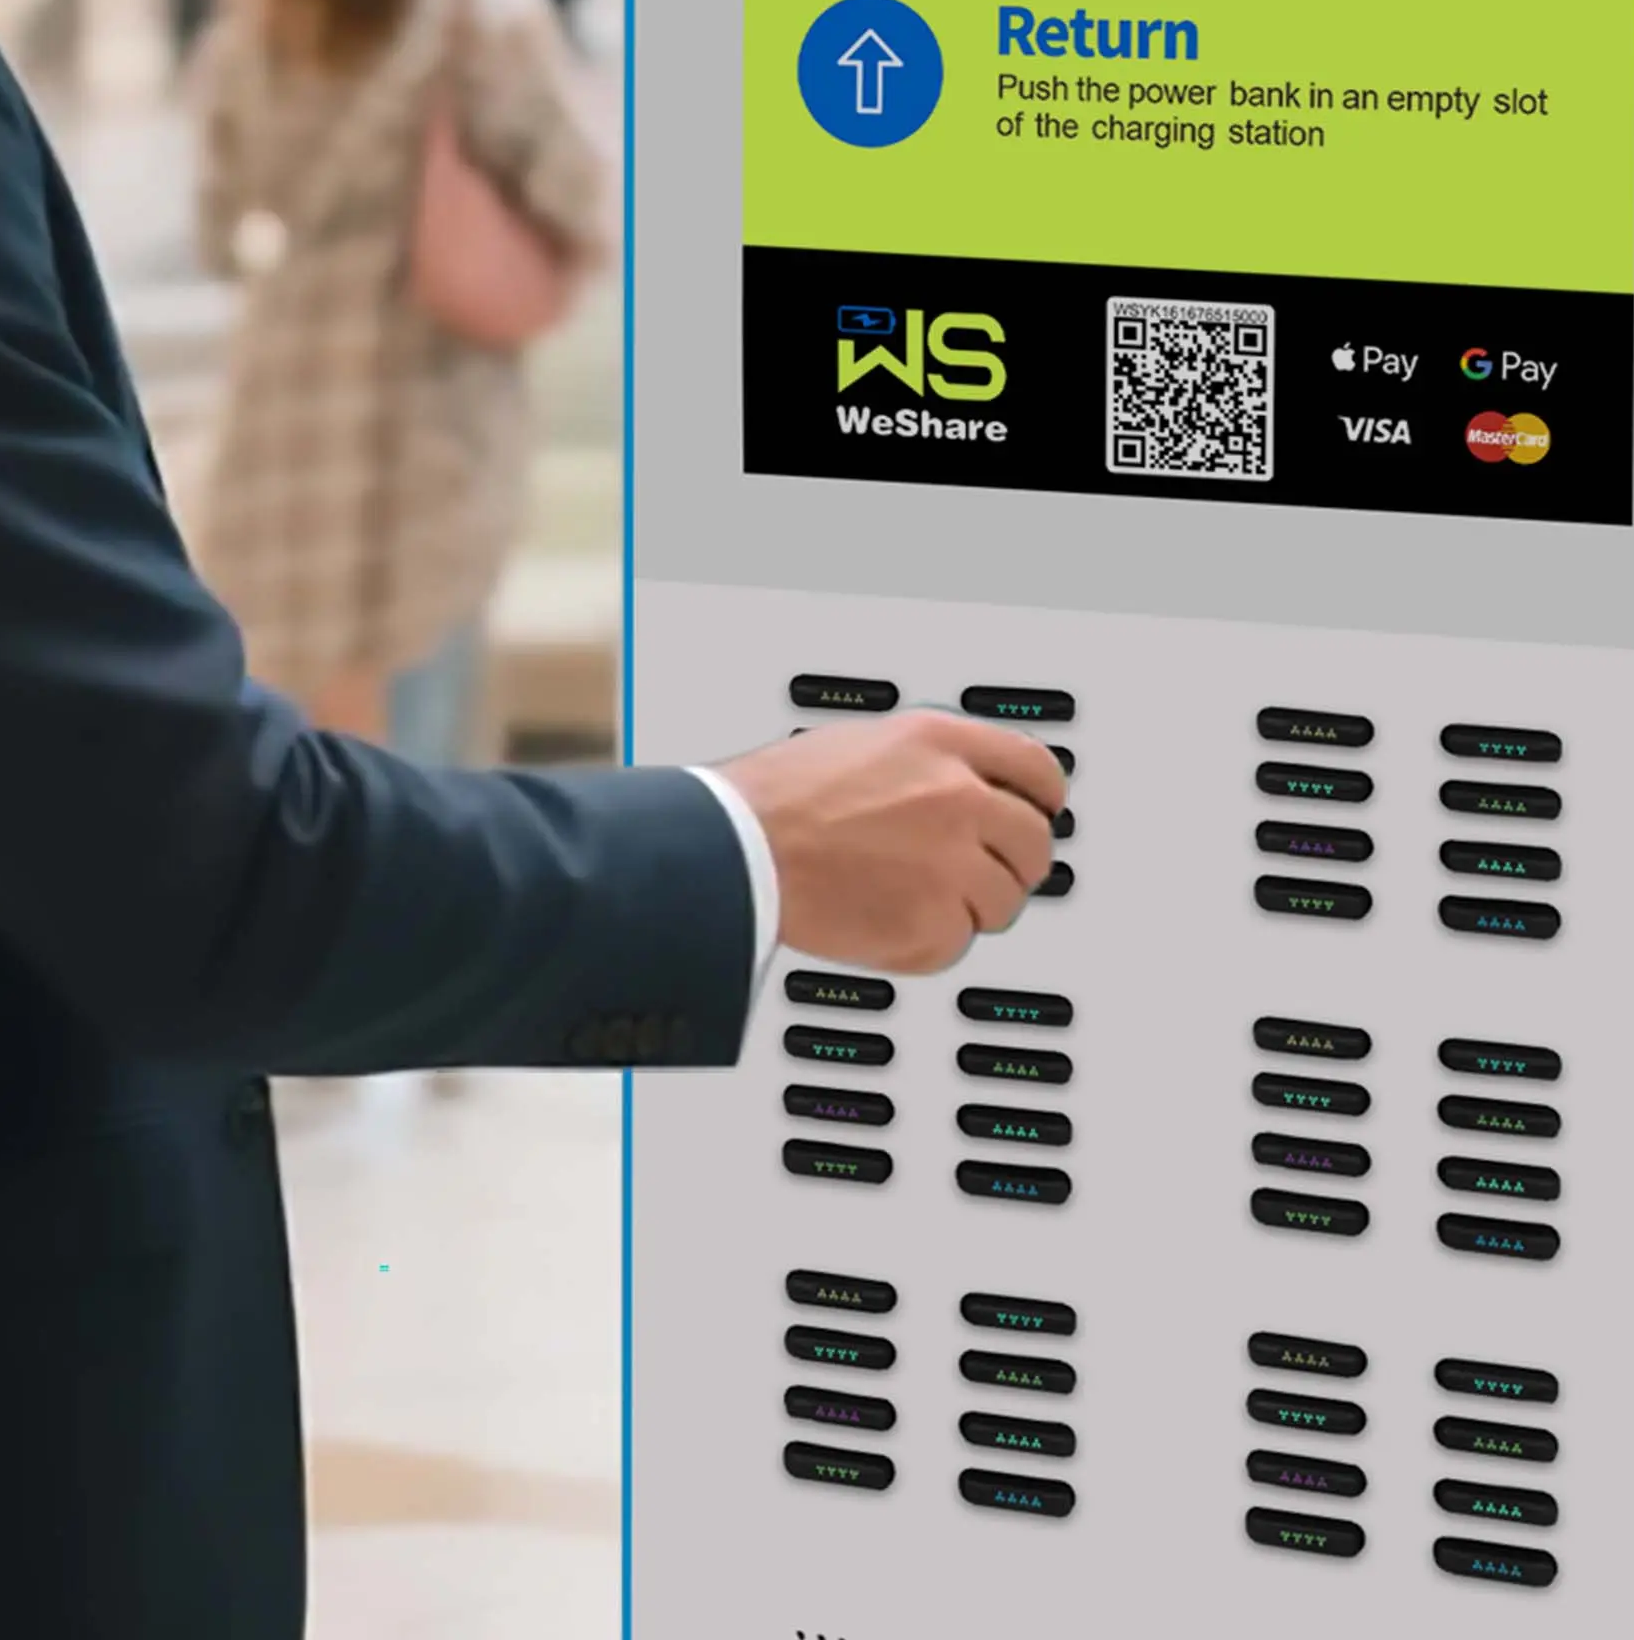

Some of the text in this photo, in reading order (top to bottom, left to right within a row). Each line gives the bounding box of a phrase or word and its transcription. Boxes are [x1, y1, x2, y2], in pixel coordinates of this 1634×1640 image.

[999, 6, 1198, 60] Return
[999, 74, 1548, 120] Push the power bank in an empty slot
[997, 112, 1323, 150] of the charging station
[1364, 346, 1418, 381] Pay
[1502, 352, 1557, 390] Pay
[837, 406, 1007, 441] WeShare
[1339, 416, 1411, 444] VISA
[1467, 427, 1549, 448] MasterCard
